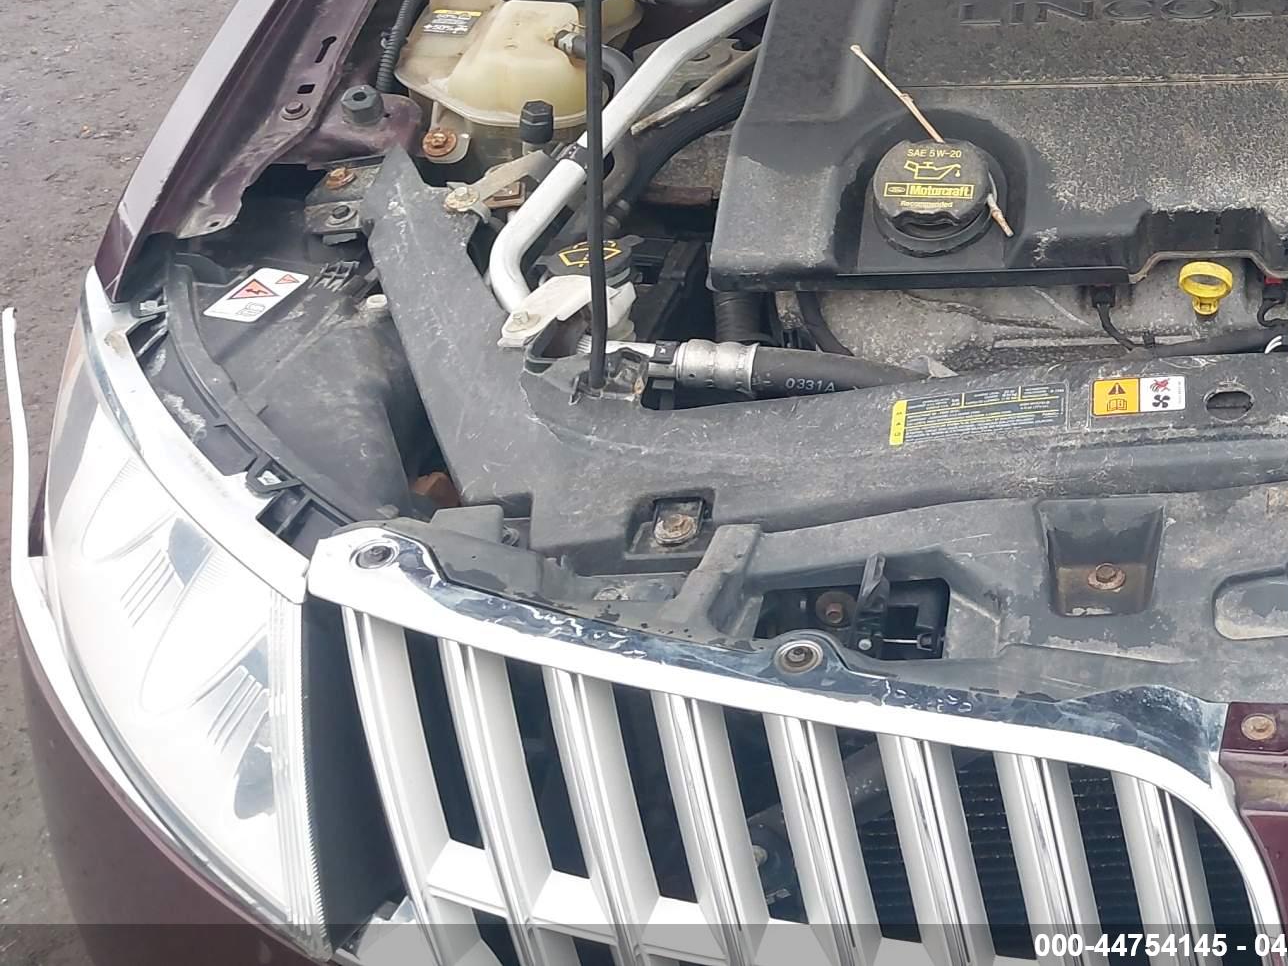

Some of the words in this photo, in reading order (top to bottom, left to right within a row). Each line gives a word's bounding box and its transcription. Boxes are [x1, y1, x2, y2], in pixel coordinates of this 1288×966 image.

[906, 148, 927, 157] SAE
[928, 149, 962, 158] 5W-20
[909, 185, 970, 197] Motorcraft
[900, 200, 954, 209] Recommended
[785, 377, 836, 393] 0331A
